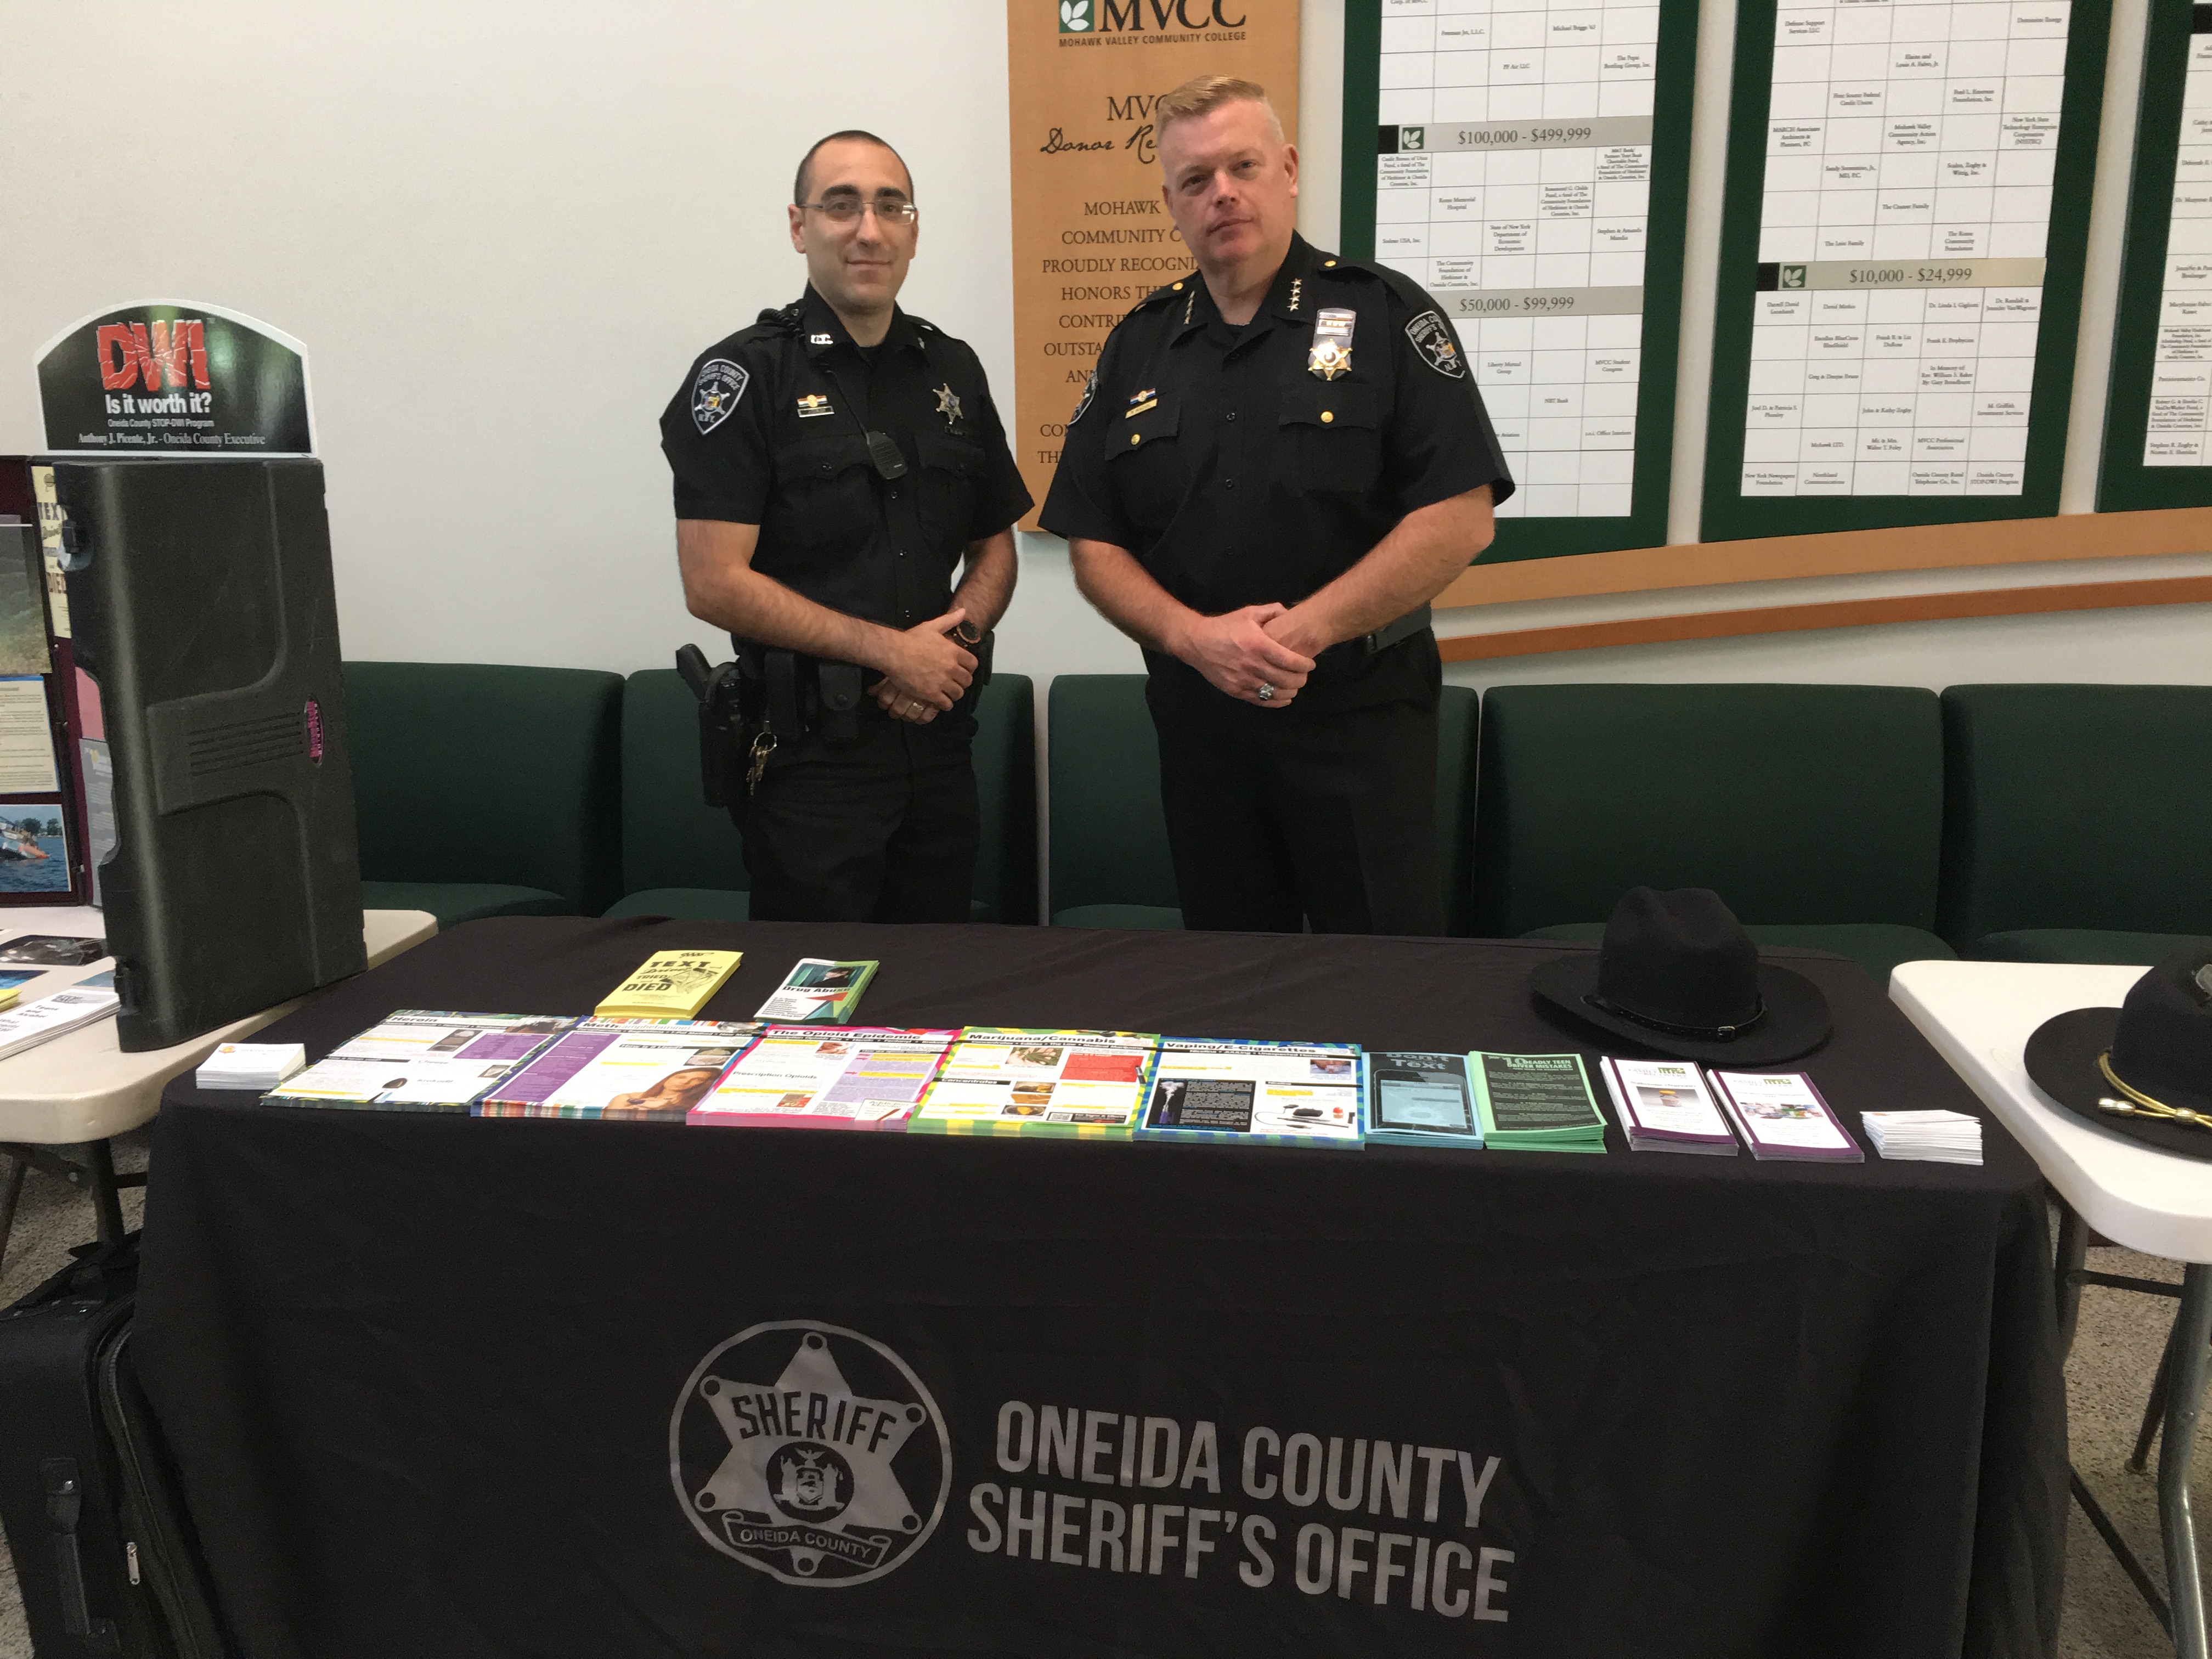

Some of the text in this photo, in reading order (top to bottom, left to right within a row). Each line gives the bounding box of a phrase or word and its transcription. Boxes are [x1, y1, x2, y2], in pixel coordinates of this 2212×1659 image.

[1099, 0, 1247, 32] MVCC
[1059, 31, 1246, 47] MOHAWK VALLEY COMMUNITY COLLEGE
[1040, 127, 1115, 155] Donor
[1458, 129, 1519, 145] $100,000
[1531, 127, 1592, 144] $499,999
[1084, 200, 1161, 217] MOHAWK
[1061, 229, 1166, 246] COMMUNITY
[1043, 256, 1200, 274] PROUDLY RECOGNI
[1849, 268, 1904, 284] $10,000
[1917, 267, 1973, 283] $24,999
[1061, 286, 1131, 301] HONORS
[1459, 298, 1510, 313] $50,000
[1522, 296, 1575, 311] $99,999
[96, 319, 211, 391] DWI
[105, 392, 213, 415] Is it worth it?
[108, 419, 215, 429] Oneida County STOP-DWI Program
[78, 432, 108, 445] Anthony
[146, 433, 159, 444] Jr.
[163, 433, 192, 444] Oneida
[193, 433, 223, 447] County
[224, 432, 266, 444] Executive
[622, 983, 673, 992] DIED
[582, 1022, 691, 1031] Meth(amphetamine)
[969, 1034, 1116, 1044] Marijuana/Cannabis
[1166, 1042, 1316, 1053] Vaping/E-Cigarettes
[1392, 1059, 1446, 1070] Text
[733, 1070, 783, 1079] Prescription
[731, 1389, 898, 1454] SHERIFF
[995, 1400, 1502, 1528] ONEIDA COUNTY
[740, 1525, 873, 1558] ONEIDA COUNTY
[966, 1482, 1516, 1622] SHERIFF'S OFFICE
